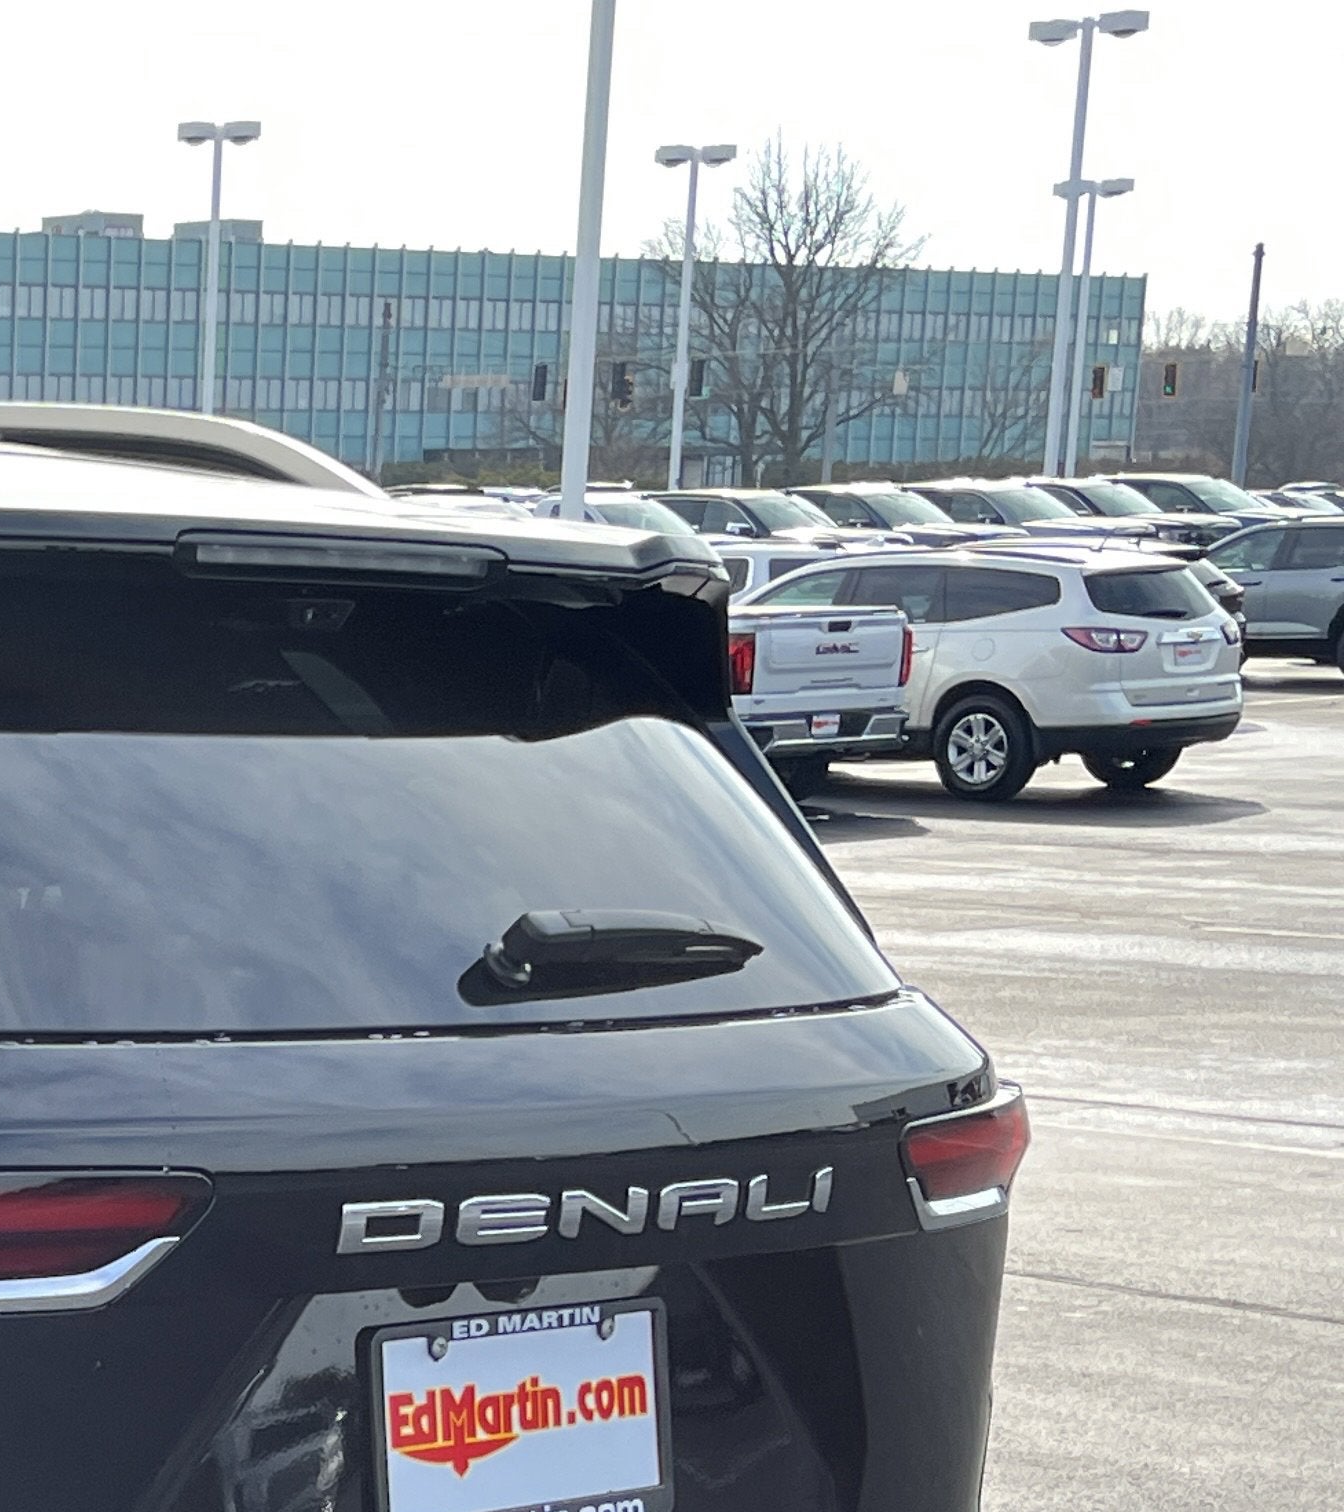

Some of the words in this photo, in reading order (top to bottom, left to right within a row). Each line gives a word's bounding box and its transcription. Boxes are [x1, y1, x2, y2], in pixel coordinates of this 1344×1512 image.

[336, 1166, 833, 1255] DENALI
[450, 1317, 490, 1341] ED
[496, 1305, 602, 1335] MARTIN
[388, 1373, 648, 1452] EdMartin.com
